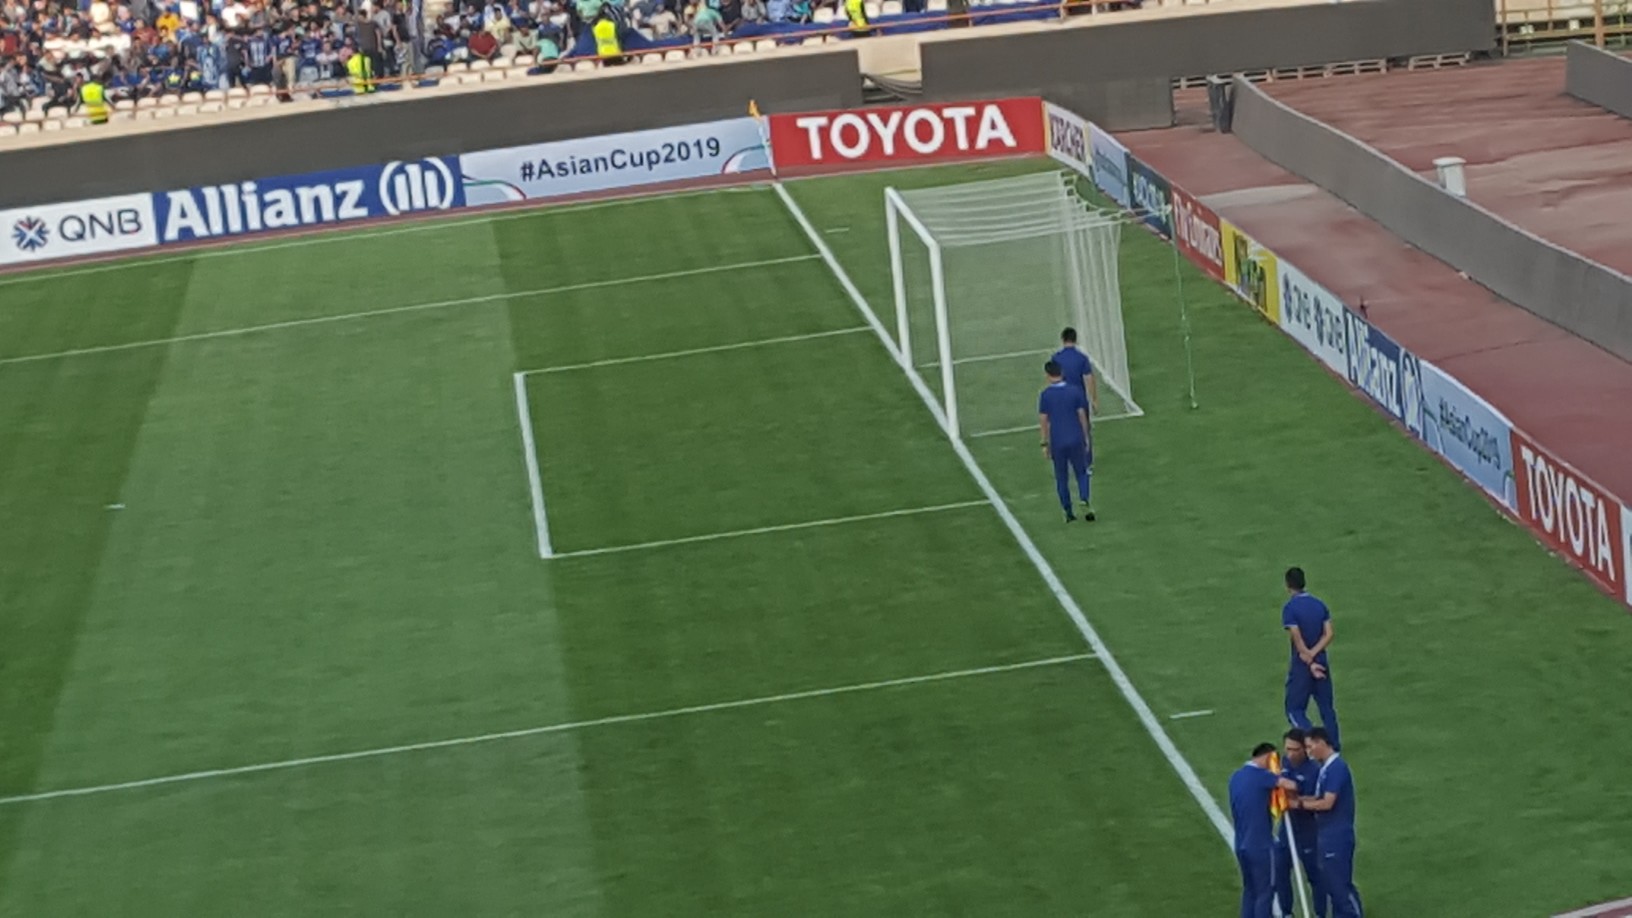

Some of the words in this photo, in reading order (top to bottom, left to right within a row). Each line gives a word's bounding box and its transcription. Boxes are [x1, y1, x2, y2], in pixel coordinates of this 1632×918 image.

[520, 137, 721, 182] #AsianCup2019
[796, 104, 1016, 160] TOYOTA
[58, 208, 143, 242] QNB
[165, 179, 368, 241] Allianz
[1520, 445, 1616, 582] TOYOTA
